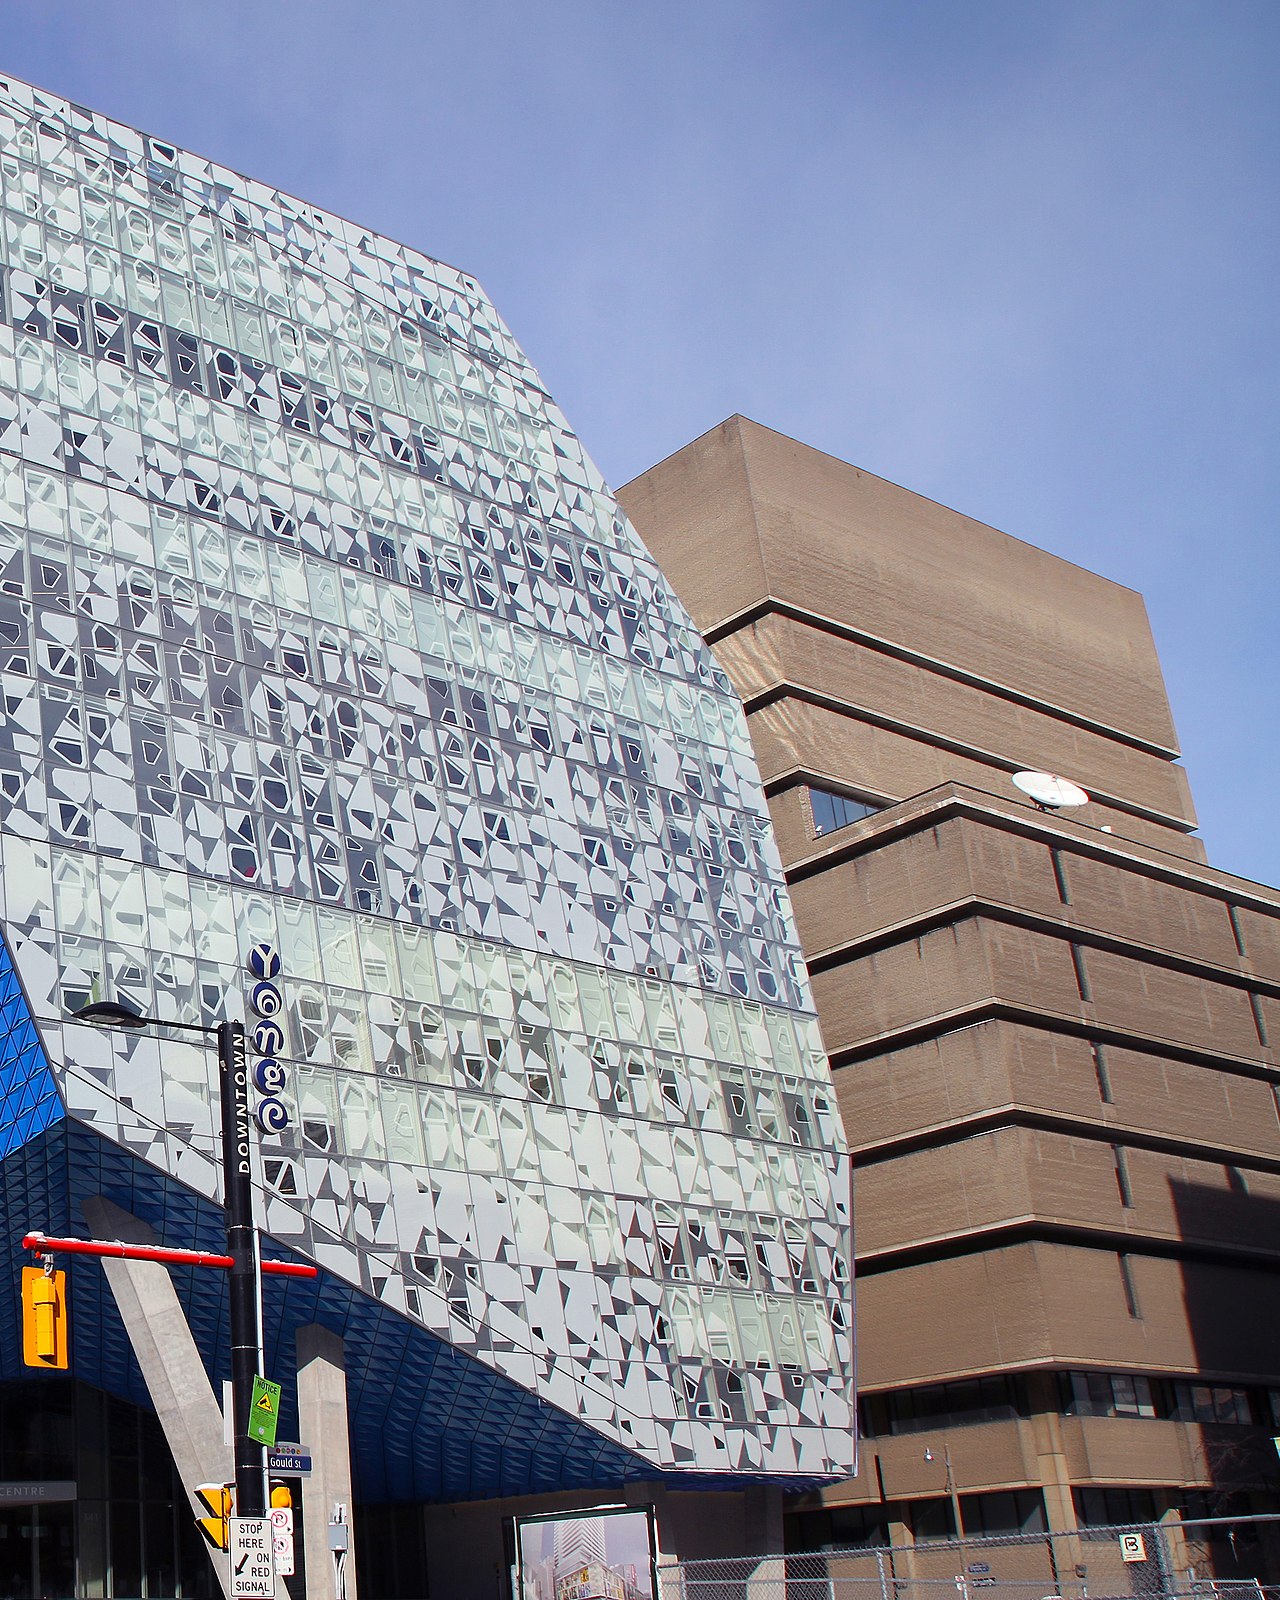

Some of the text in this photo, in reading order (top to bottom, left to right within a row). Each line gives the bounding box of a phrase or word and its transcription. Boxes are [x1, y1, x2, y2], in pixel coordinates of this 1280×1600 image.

[253, 943, 287, 1134] Yonge
[232, 1033, 250, 1174] DOWNTOWN
[257, 1379, 278, 1396] NOTICE
[270, 1456, 302, 1468] Gould St
[239, 1523, 263, 1534] STOP
[238, 1538, 264, 1549] HERE
[256, 1552, 270, 1563] ON
[251, 1567, 270, 1577] RED
[235, 1581, 270, 1592] SIGNAL
